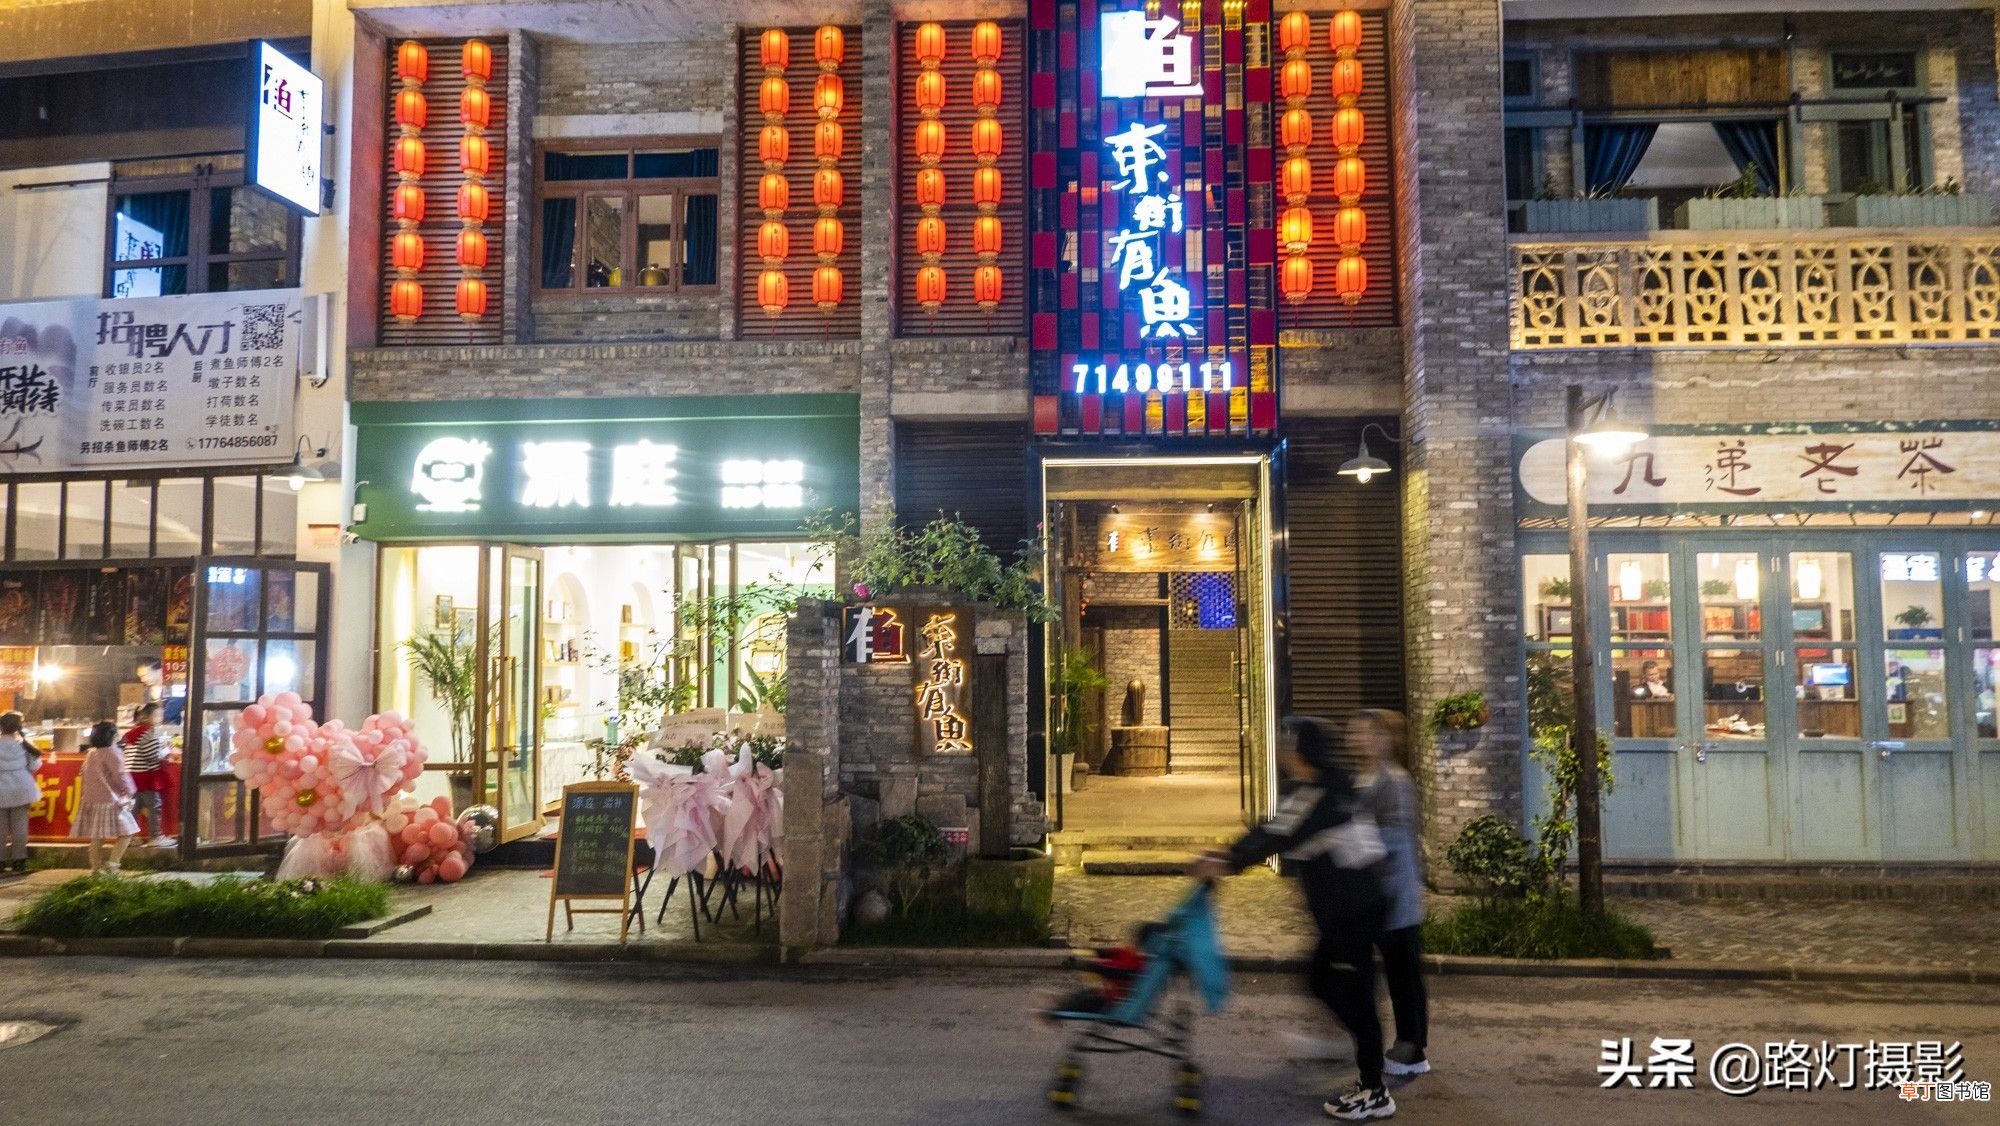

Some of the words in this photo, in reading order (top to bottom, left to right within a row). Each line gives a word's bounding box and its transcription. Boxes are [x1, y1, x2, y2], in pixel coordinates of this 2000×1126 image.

[97, 310, 236, 358] 招聘人才
[105, 362, 164, 376] 收银员2名
[210, 354, 284, 370] 煮鱼师傅2名
[1072, 361, 1232, 394] 71499111
[103, 380, 168, 394] 服务员数名
[102, 398, 165, 413] 传菜员数名
[206, 394, 259, 408] 打荷数名
[100, 417, 165, 432] 洗碗工数名
[205, 412, 258, 428] 学徒数名
[80, 438, 169, 454] 另招杀鱼师傅2名
[198, 435, 278, 449] 17764856087
